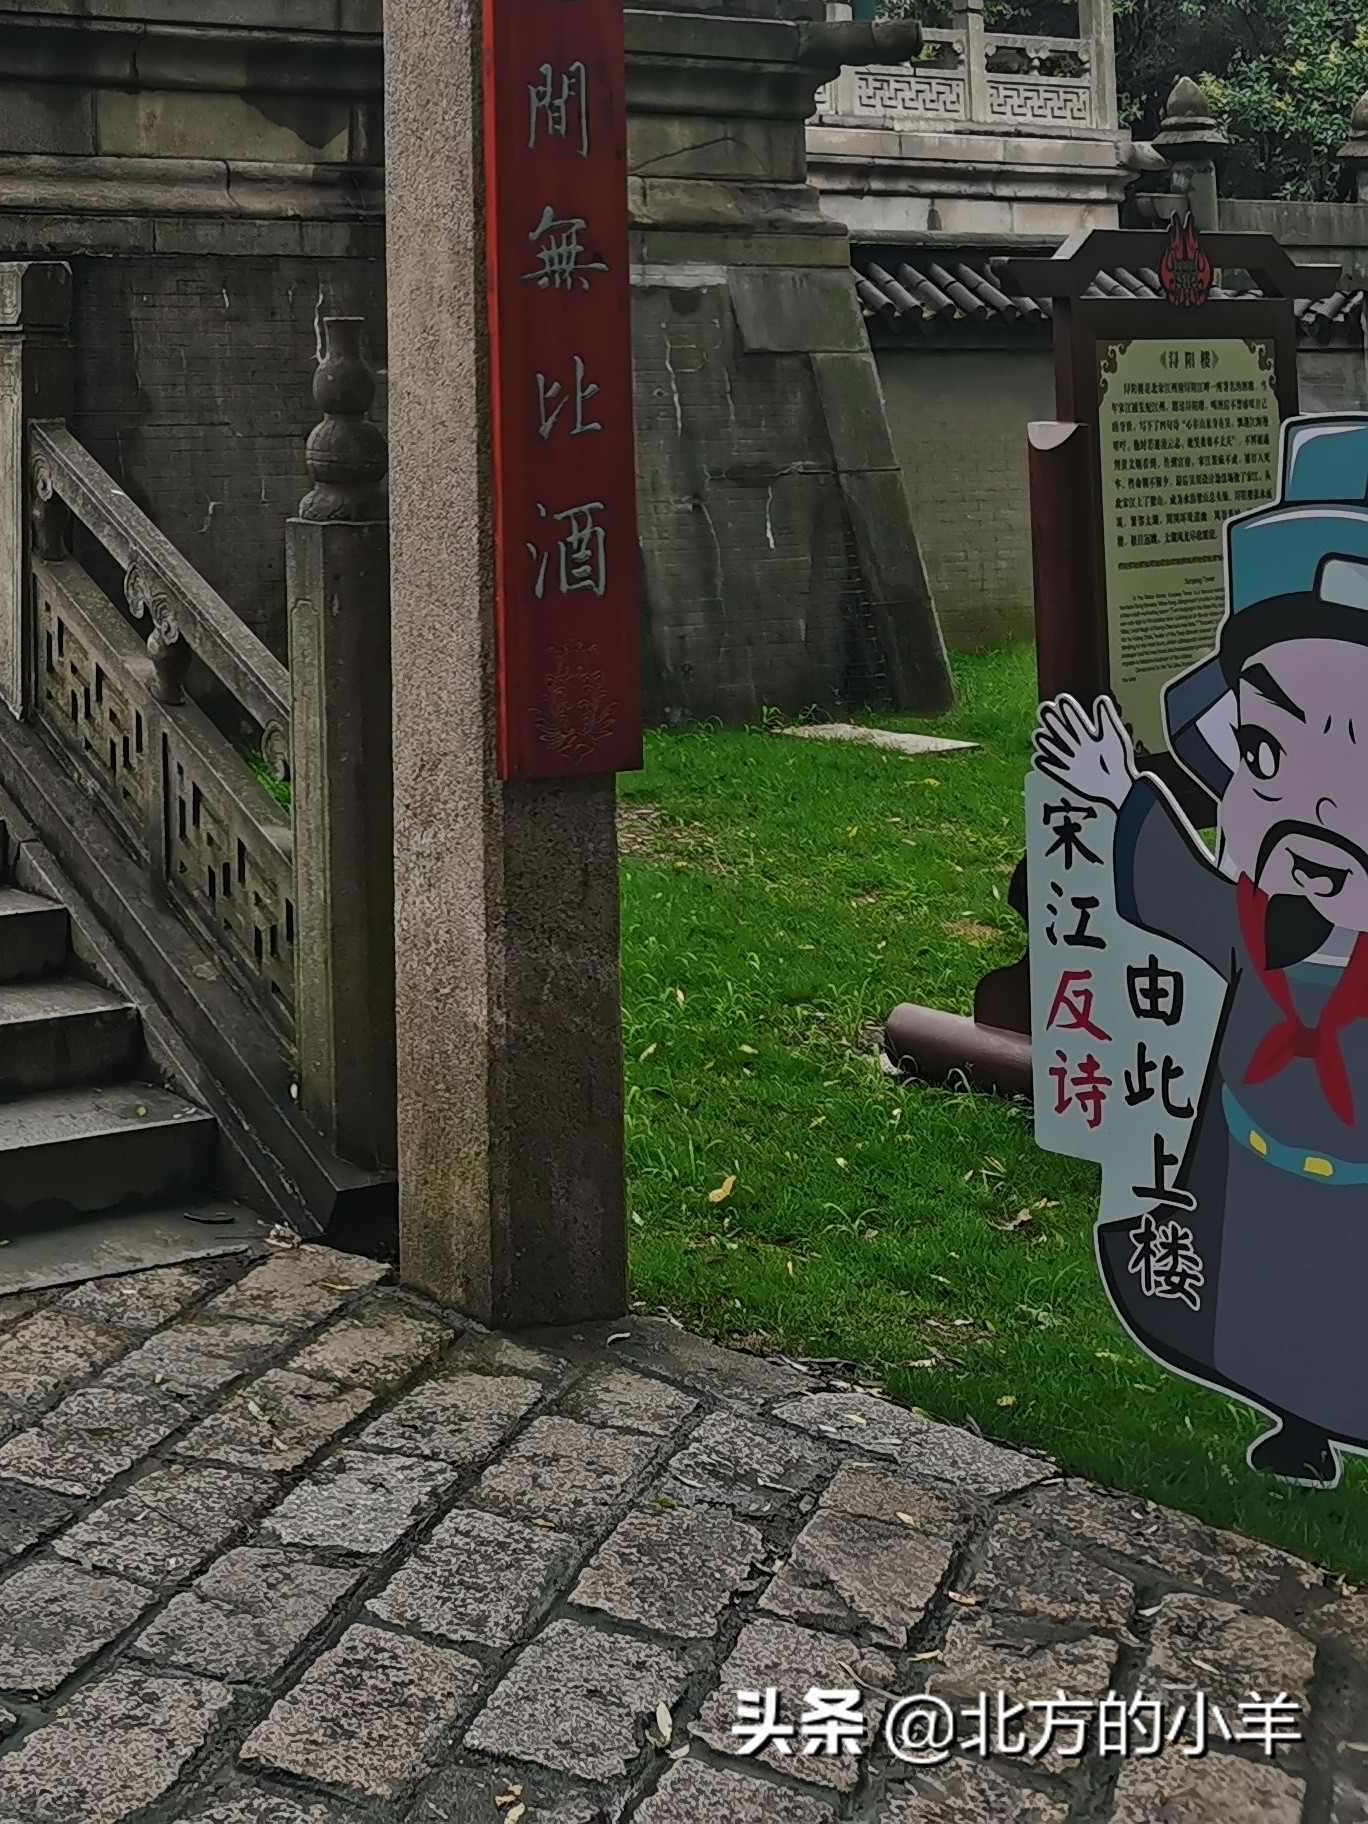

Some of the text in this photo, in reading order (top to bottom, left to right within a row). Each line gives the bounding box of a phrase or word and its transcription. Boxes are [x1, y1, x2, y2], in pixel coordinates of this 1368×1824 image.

[1043, 796, 1113, 1129] 宋江反诗
[1124, 953, 1204, 1311] 由此上楼
